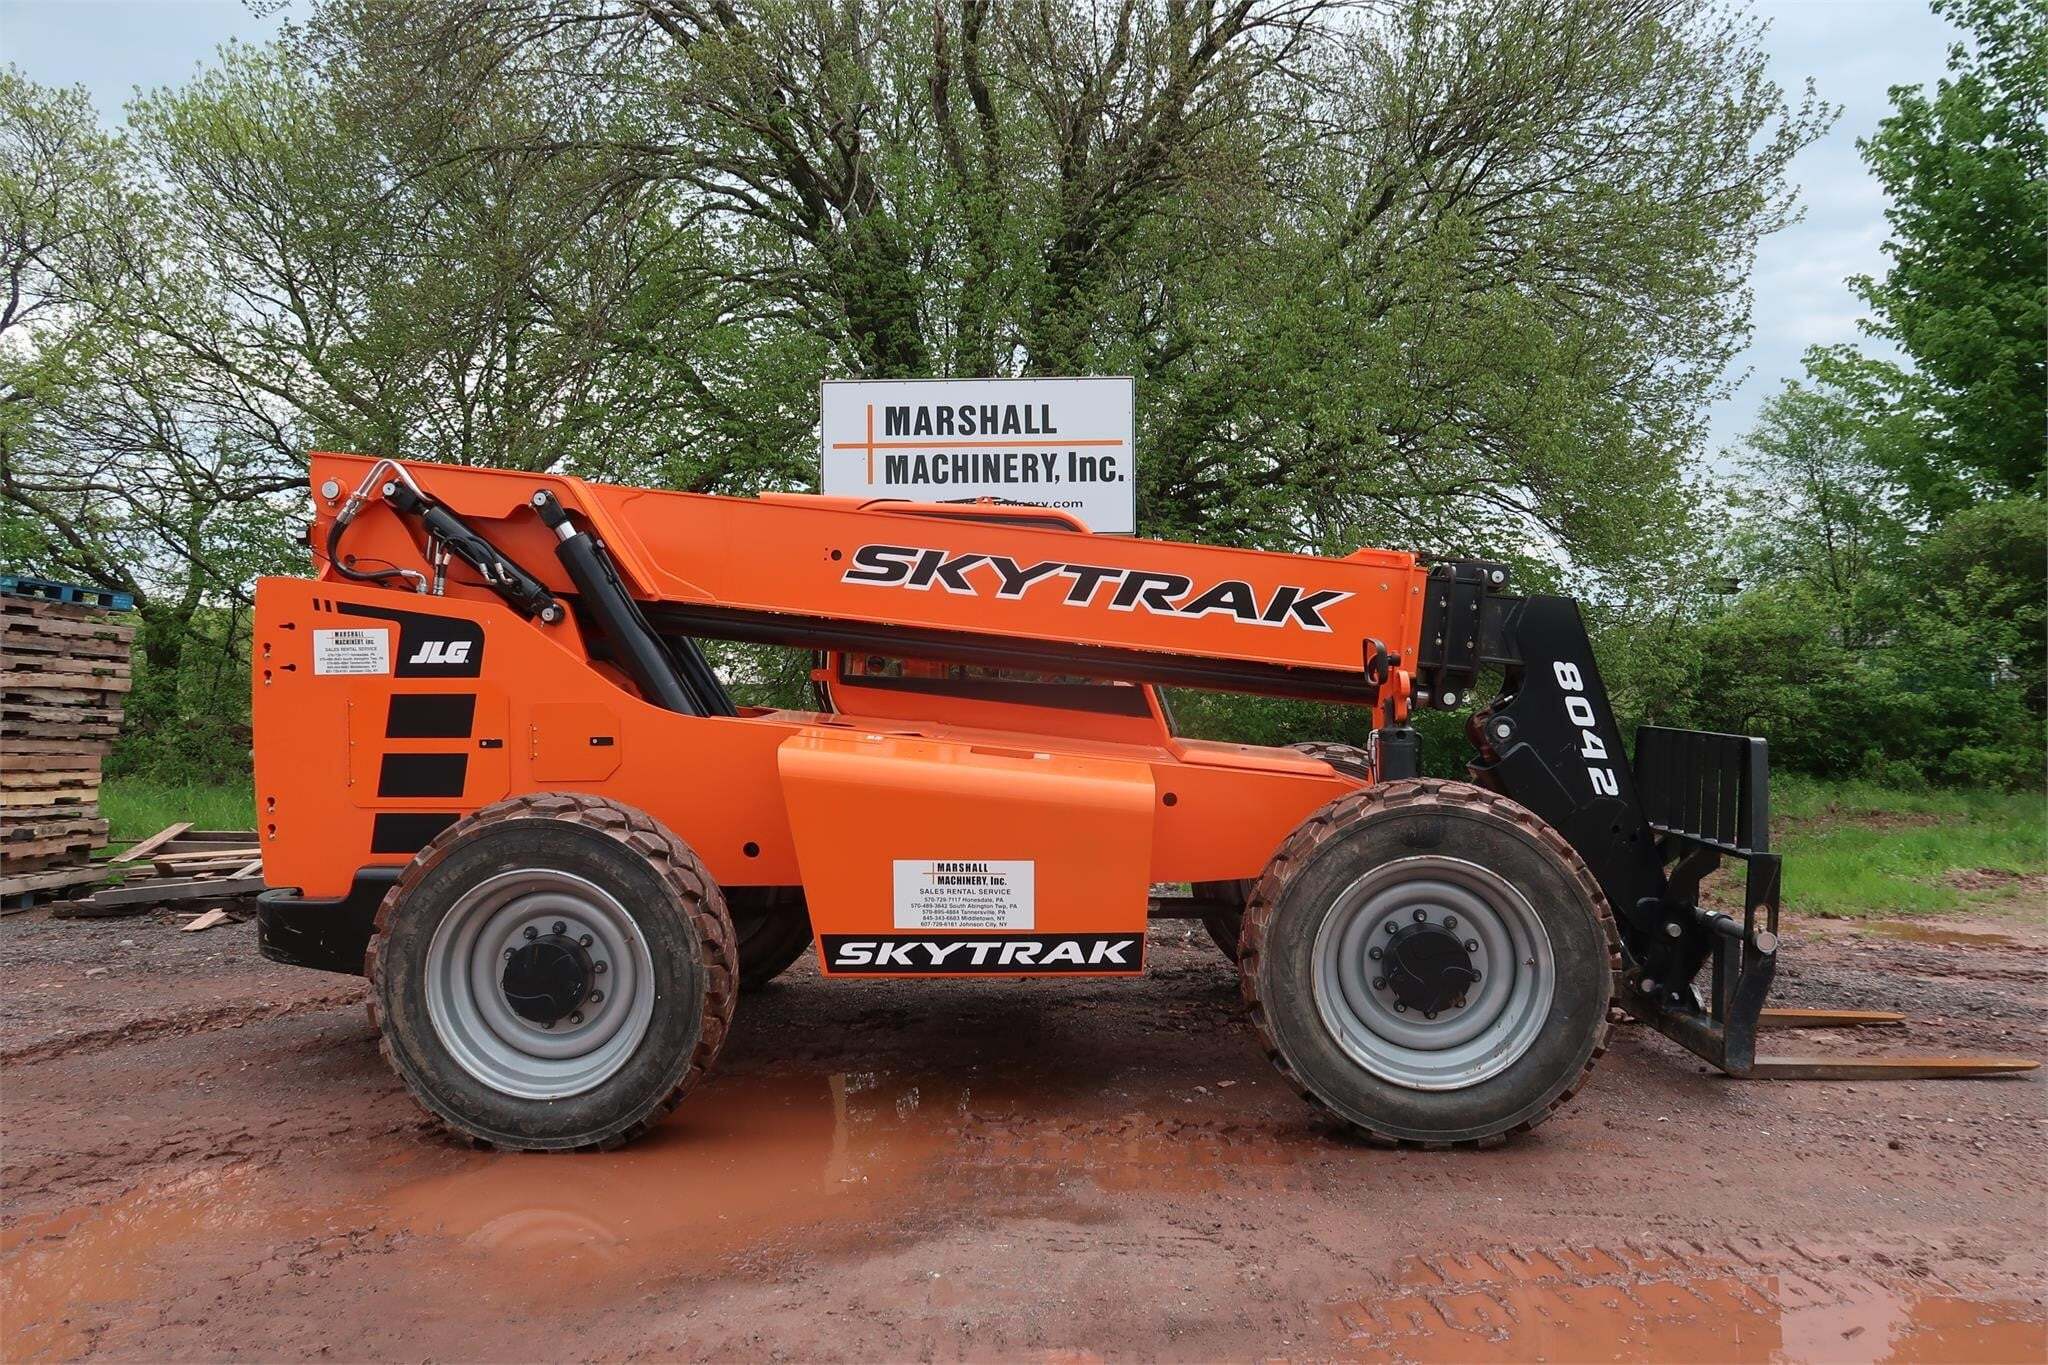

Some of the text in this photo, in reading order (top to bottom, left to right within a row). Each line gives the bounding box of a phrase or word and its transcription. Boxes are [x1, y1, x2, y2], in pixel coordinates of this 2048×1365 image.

[885, 404, 1057, 436] MARSHALL
[885, 451, 1125, 485] MACHINERY, Inc.
[841, 544, 1357, 633] SKYTRAK
[410, 641, 472, 664] JLG
[1553, 661, 1619, 796] 8042
[937, 863, 988, 872] MARSHALL
[937, 876, 1007, 886] MACHINERY, Inc.
[835, 940, 1136, 965] SKYTRAK
